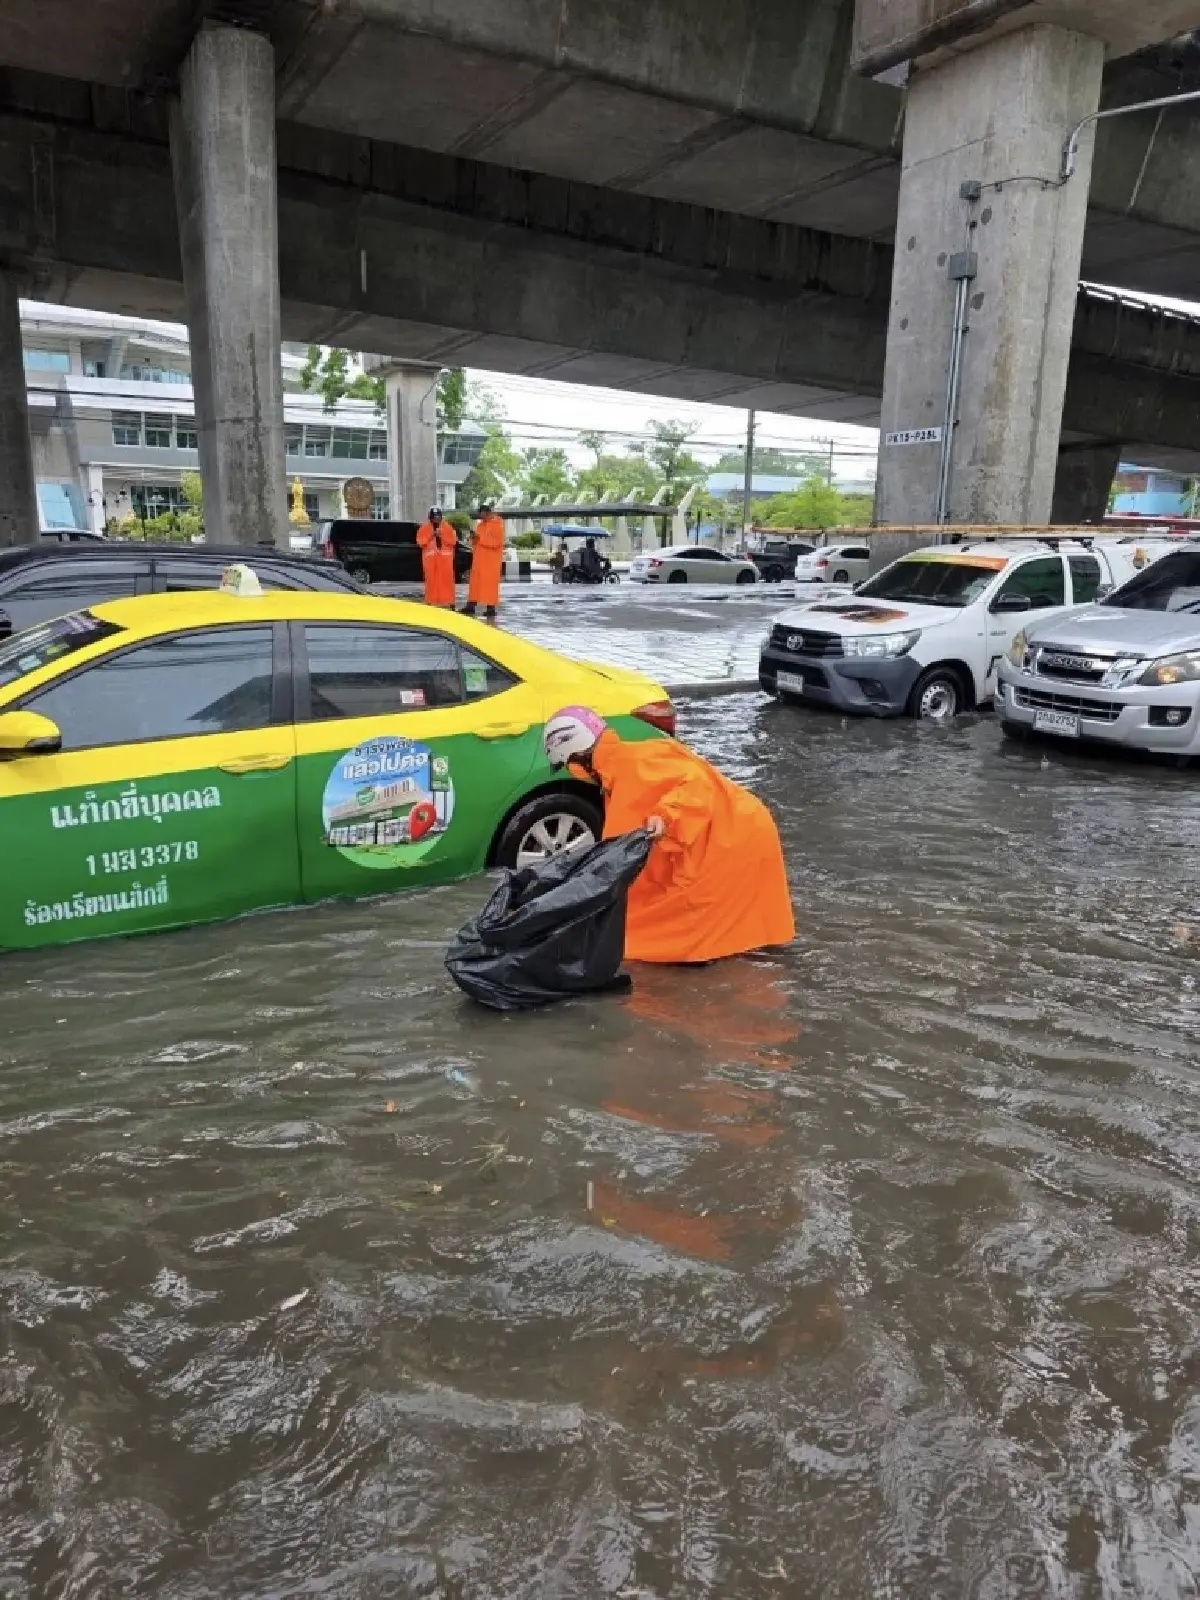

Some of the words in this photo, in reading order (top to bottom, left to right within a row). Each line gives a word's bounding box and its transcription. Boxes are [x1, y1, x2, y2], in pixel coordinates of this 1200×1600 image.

[343, 747, 428, 778] แล้วไปต่อ
[50, 781, 222, 829] แท็กซี่บุคคล
[86, 854, 96, 876] 1
[140, 840, 199, 867] 3378
